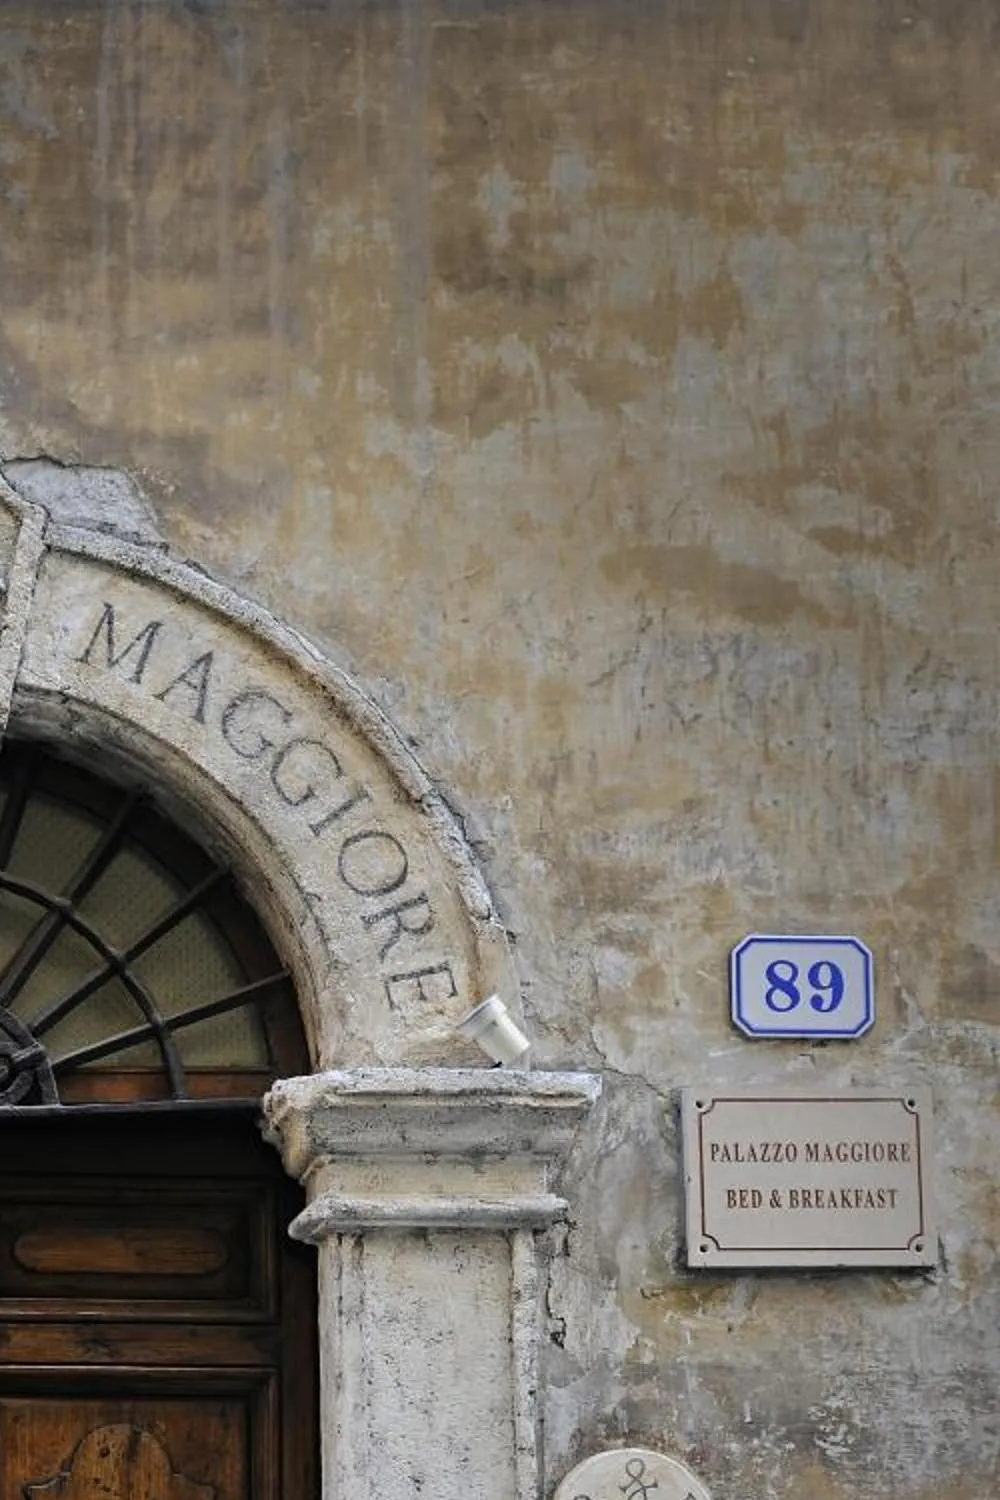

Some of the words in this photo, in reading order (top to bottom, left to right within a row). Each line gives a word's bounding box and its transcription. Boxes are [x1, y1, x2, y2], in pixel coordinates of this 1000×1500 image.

[73, 602, 458, 1009] MAGGIORE
[764, 959, 845, 1013] 89
[710, 1142, 798, 1163] PALAZZO
[804, 1142, 911, 1163] MAGGIORE
[727, 1188, 762, 1209] BED
[769, 1188, 782, 1209] &
[789, 1188, 899, 1209] BREAKFAST
